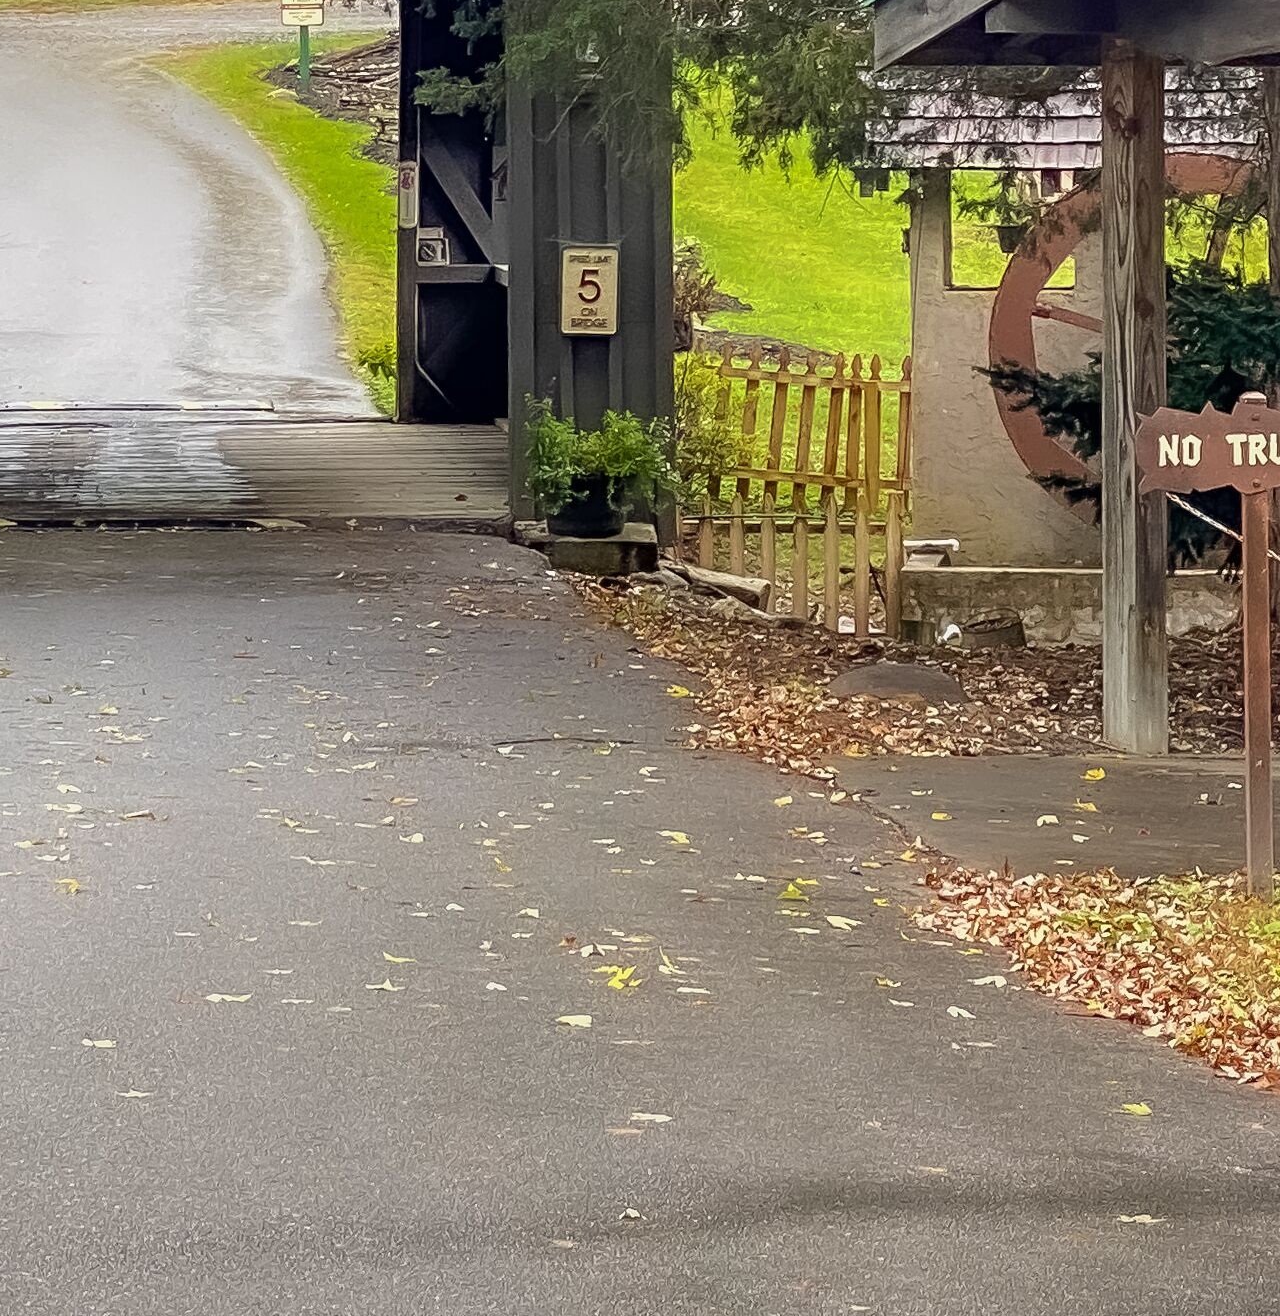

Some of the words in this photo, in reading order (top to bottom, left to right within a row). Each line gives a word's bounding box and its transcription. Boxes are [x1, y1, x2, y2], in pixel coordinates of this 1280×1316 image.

[578, 269, 602, 304] 5
[570, 317, 608, 328] BRIDGE
[581, 307, 598, 317] ON
[1158, 433, 1203, 467] NO
